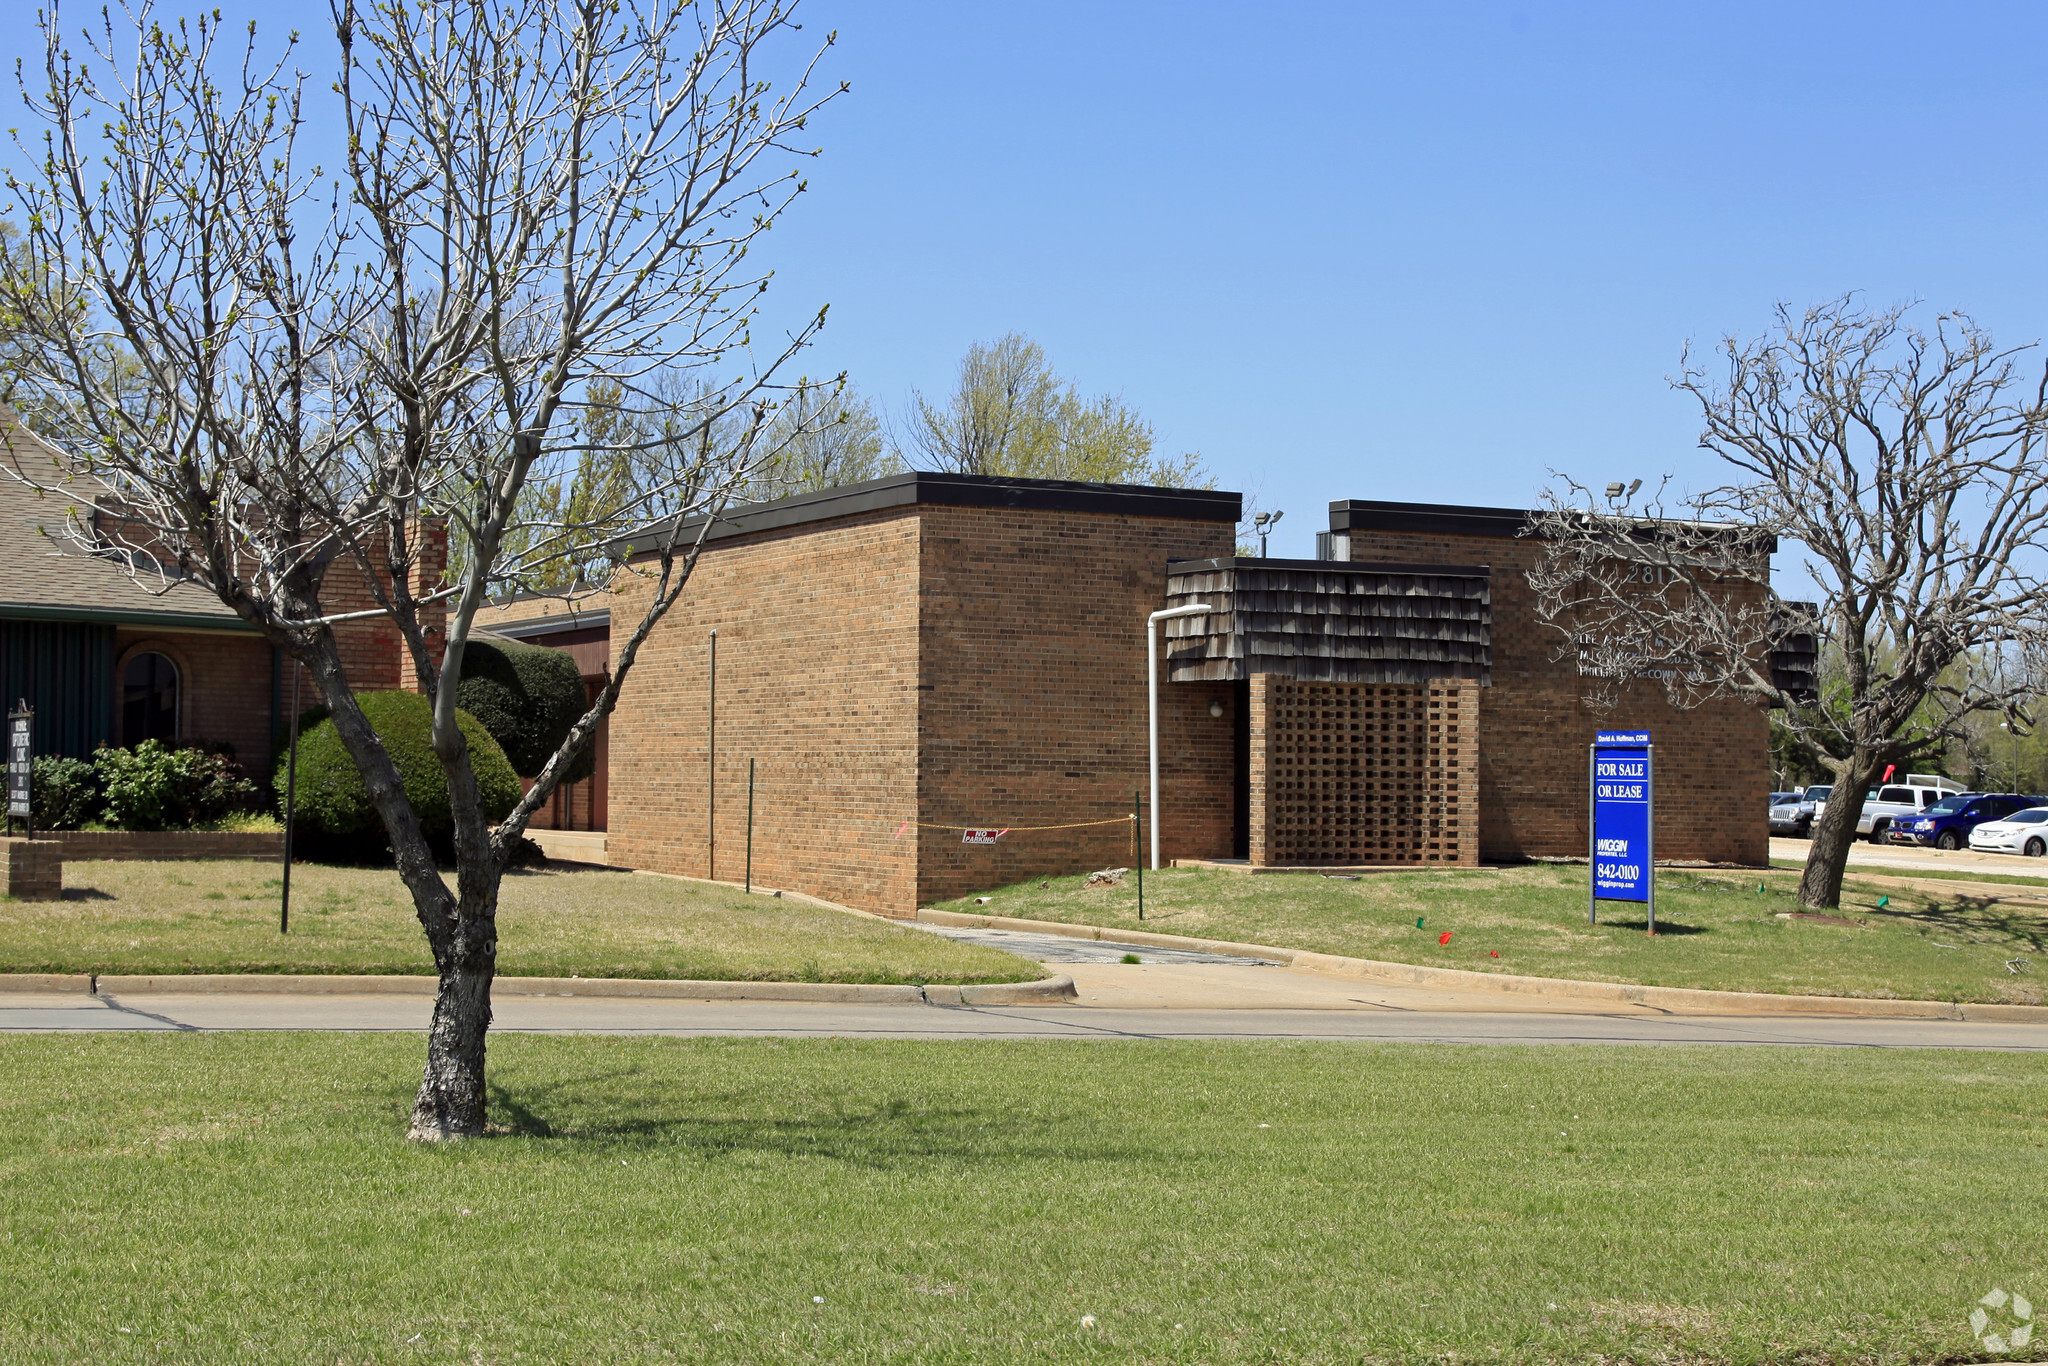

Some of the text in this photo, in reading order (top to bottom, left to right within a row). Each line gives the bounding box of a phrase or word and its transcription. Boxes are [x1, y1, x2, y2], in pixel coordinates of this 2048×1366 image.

[1627, 566, 1676, 584] 281
[1597, 763, 1644, 777] FOR SALE
[1597, 784, 1643, 798] OR LEASE
[1597, 838, 1628, 852] WIGGIN
[1597, 862, 1639, 880] 842-0100
[1597, 879, 1635, 889] wigginprop.com
